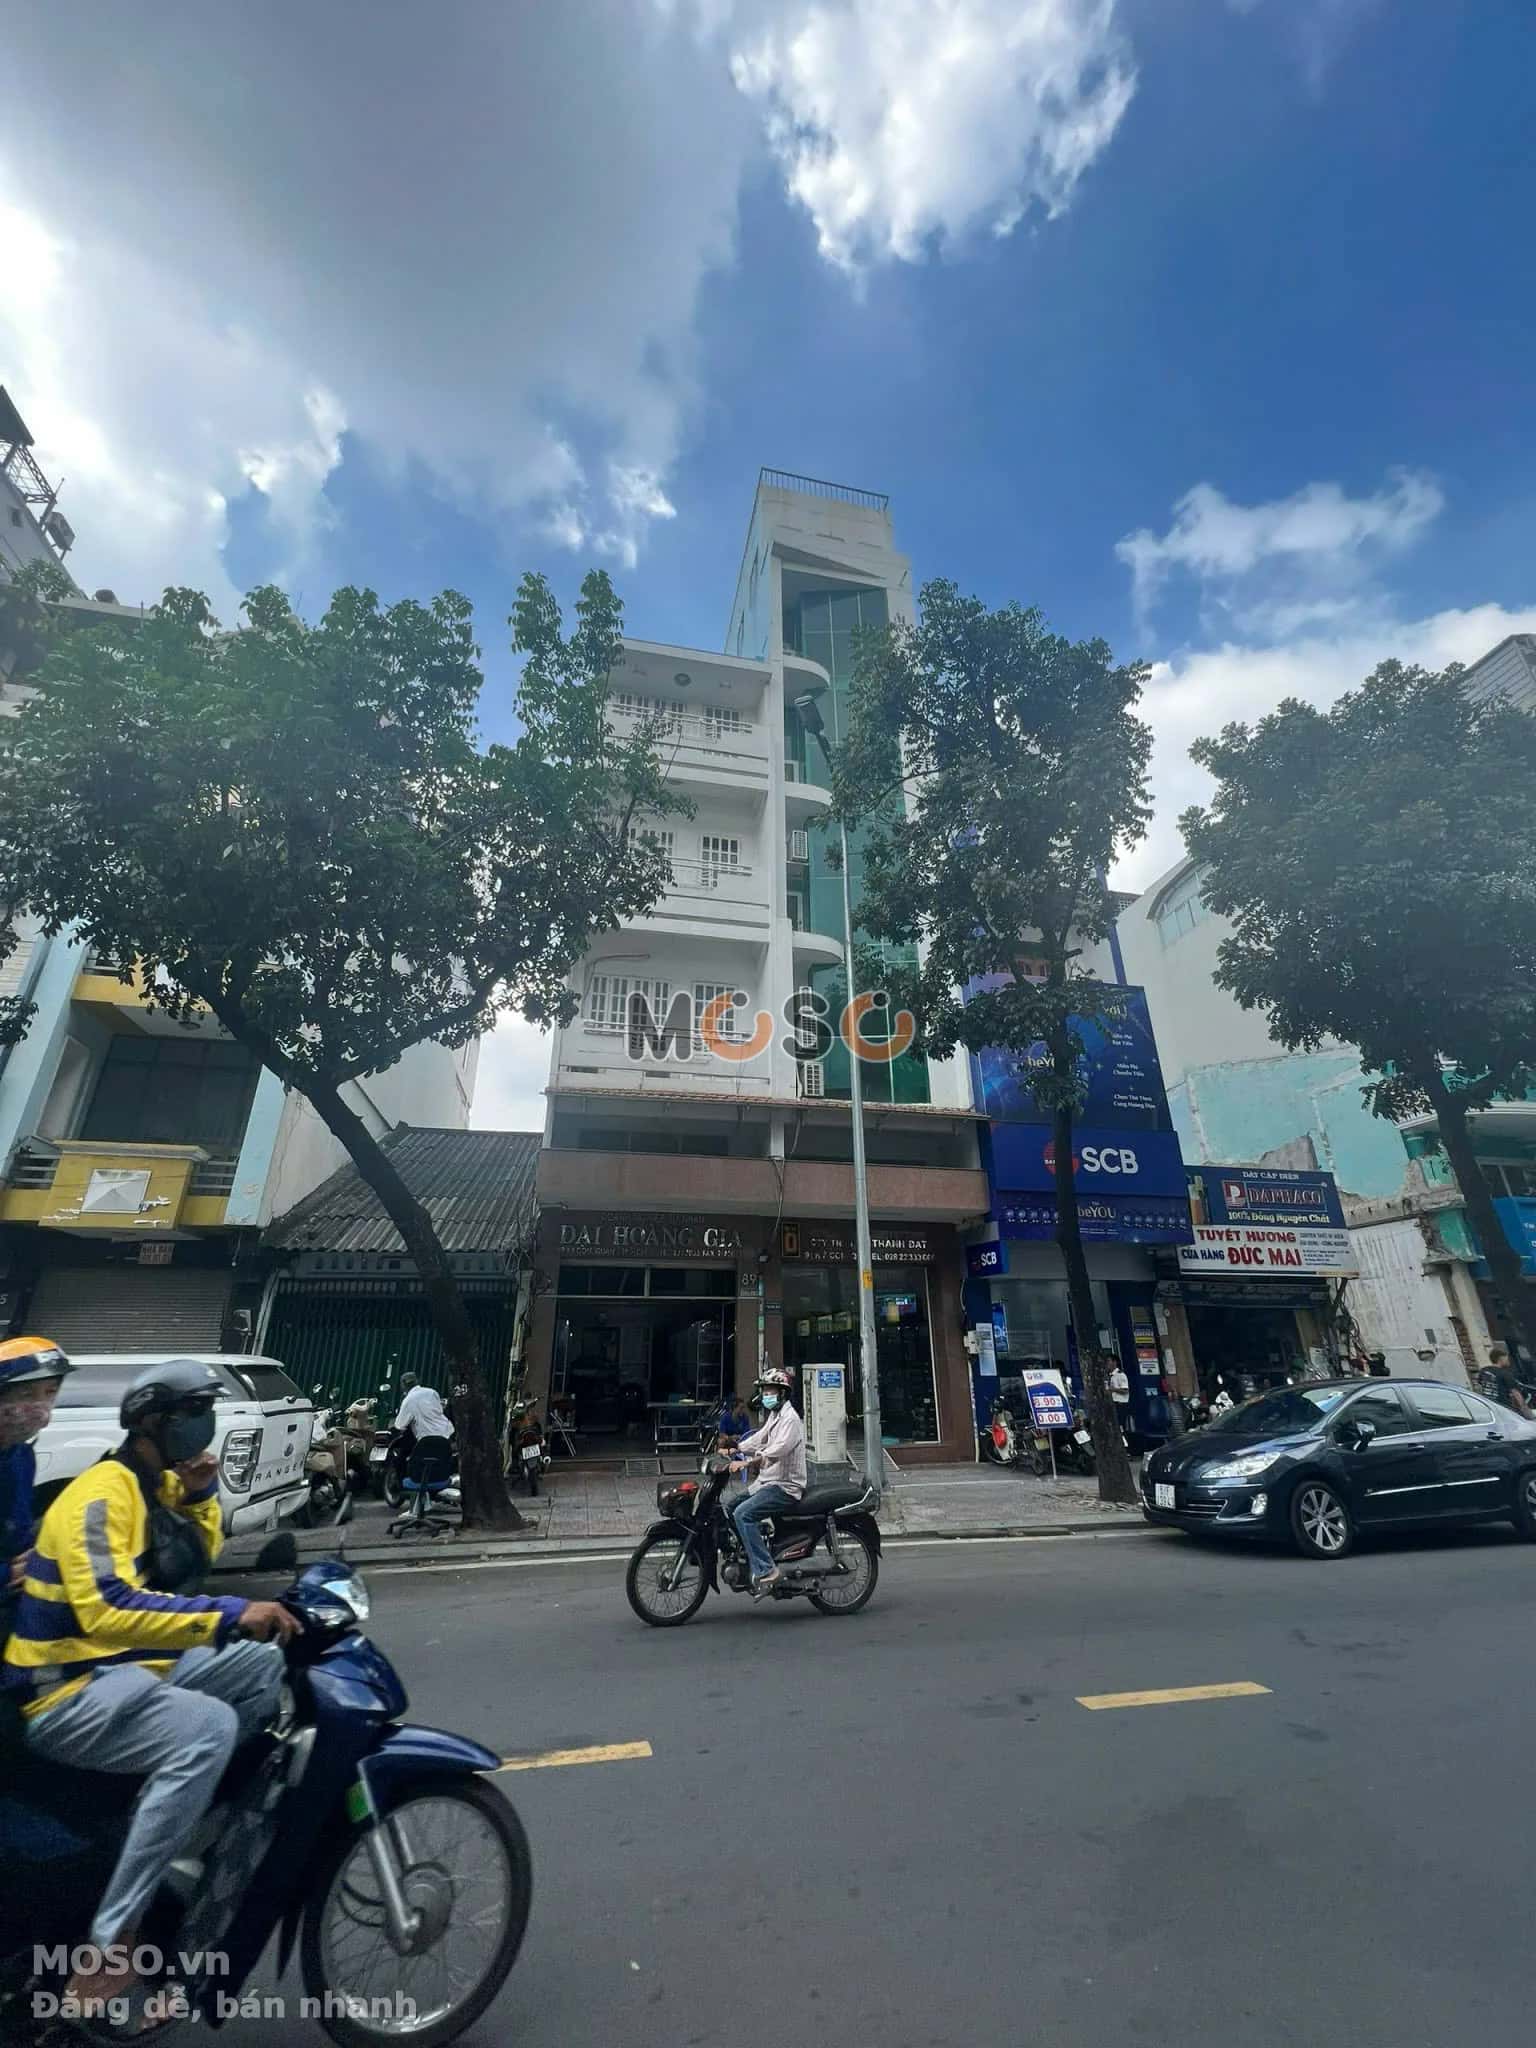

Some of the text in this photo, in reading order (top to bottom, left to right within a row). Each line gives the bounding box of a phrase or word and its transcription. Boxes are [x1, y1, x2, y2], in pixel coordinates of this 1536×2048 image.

[1081, 1146, 1139, 1174] SCB
[703, 1227, 744, 1248] GIA
[980, 1252, 997, 1266] SCB
[1268, 1247, 1303, 1266] MAI
